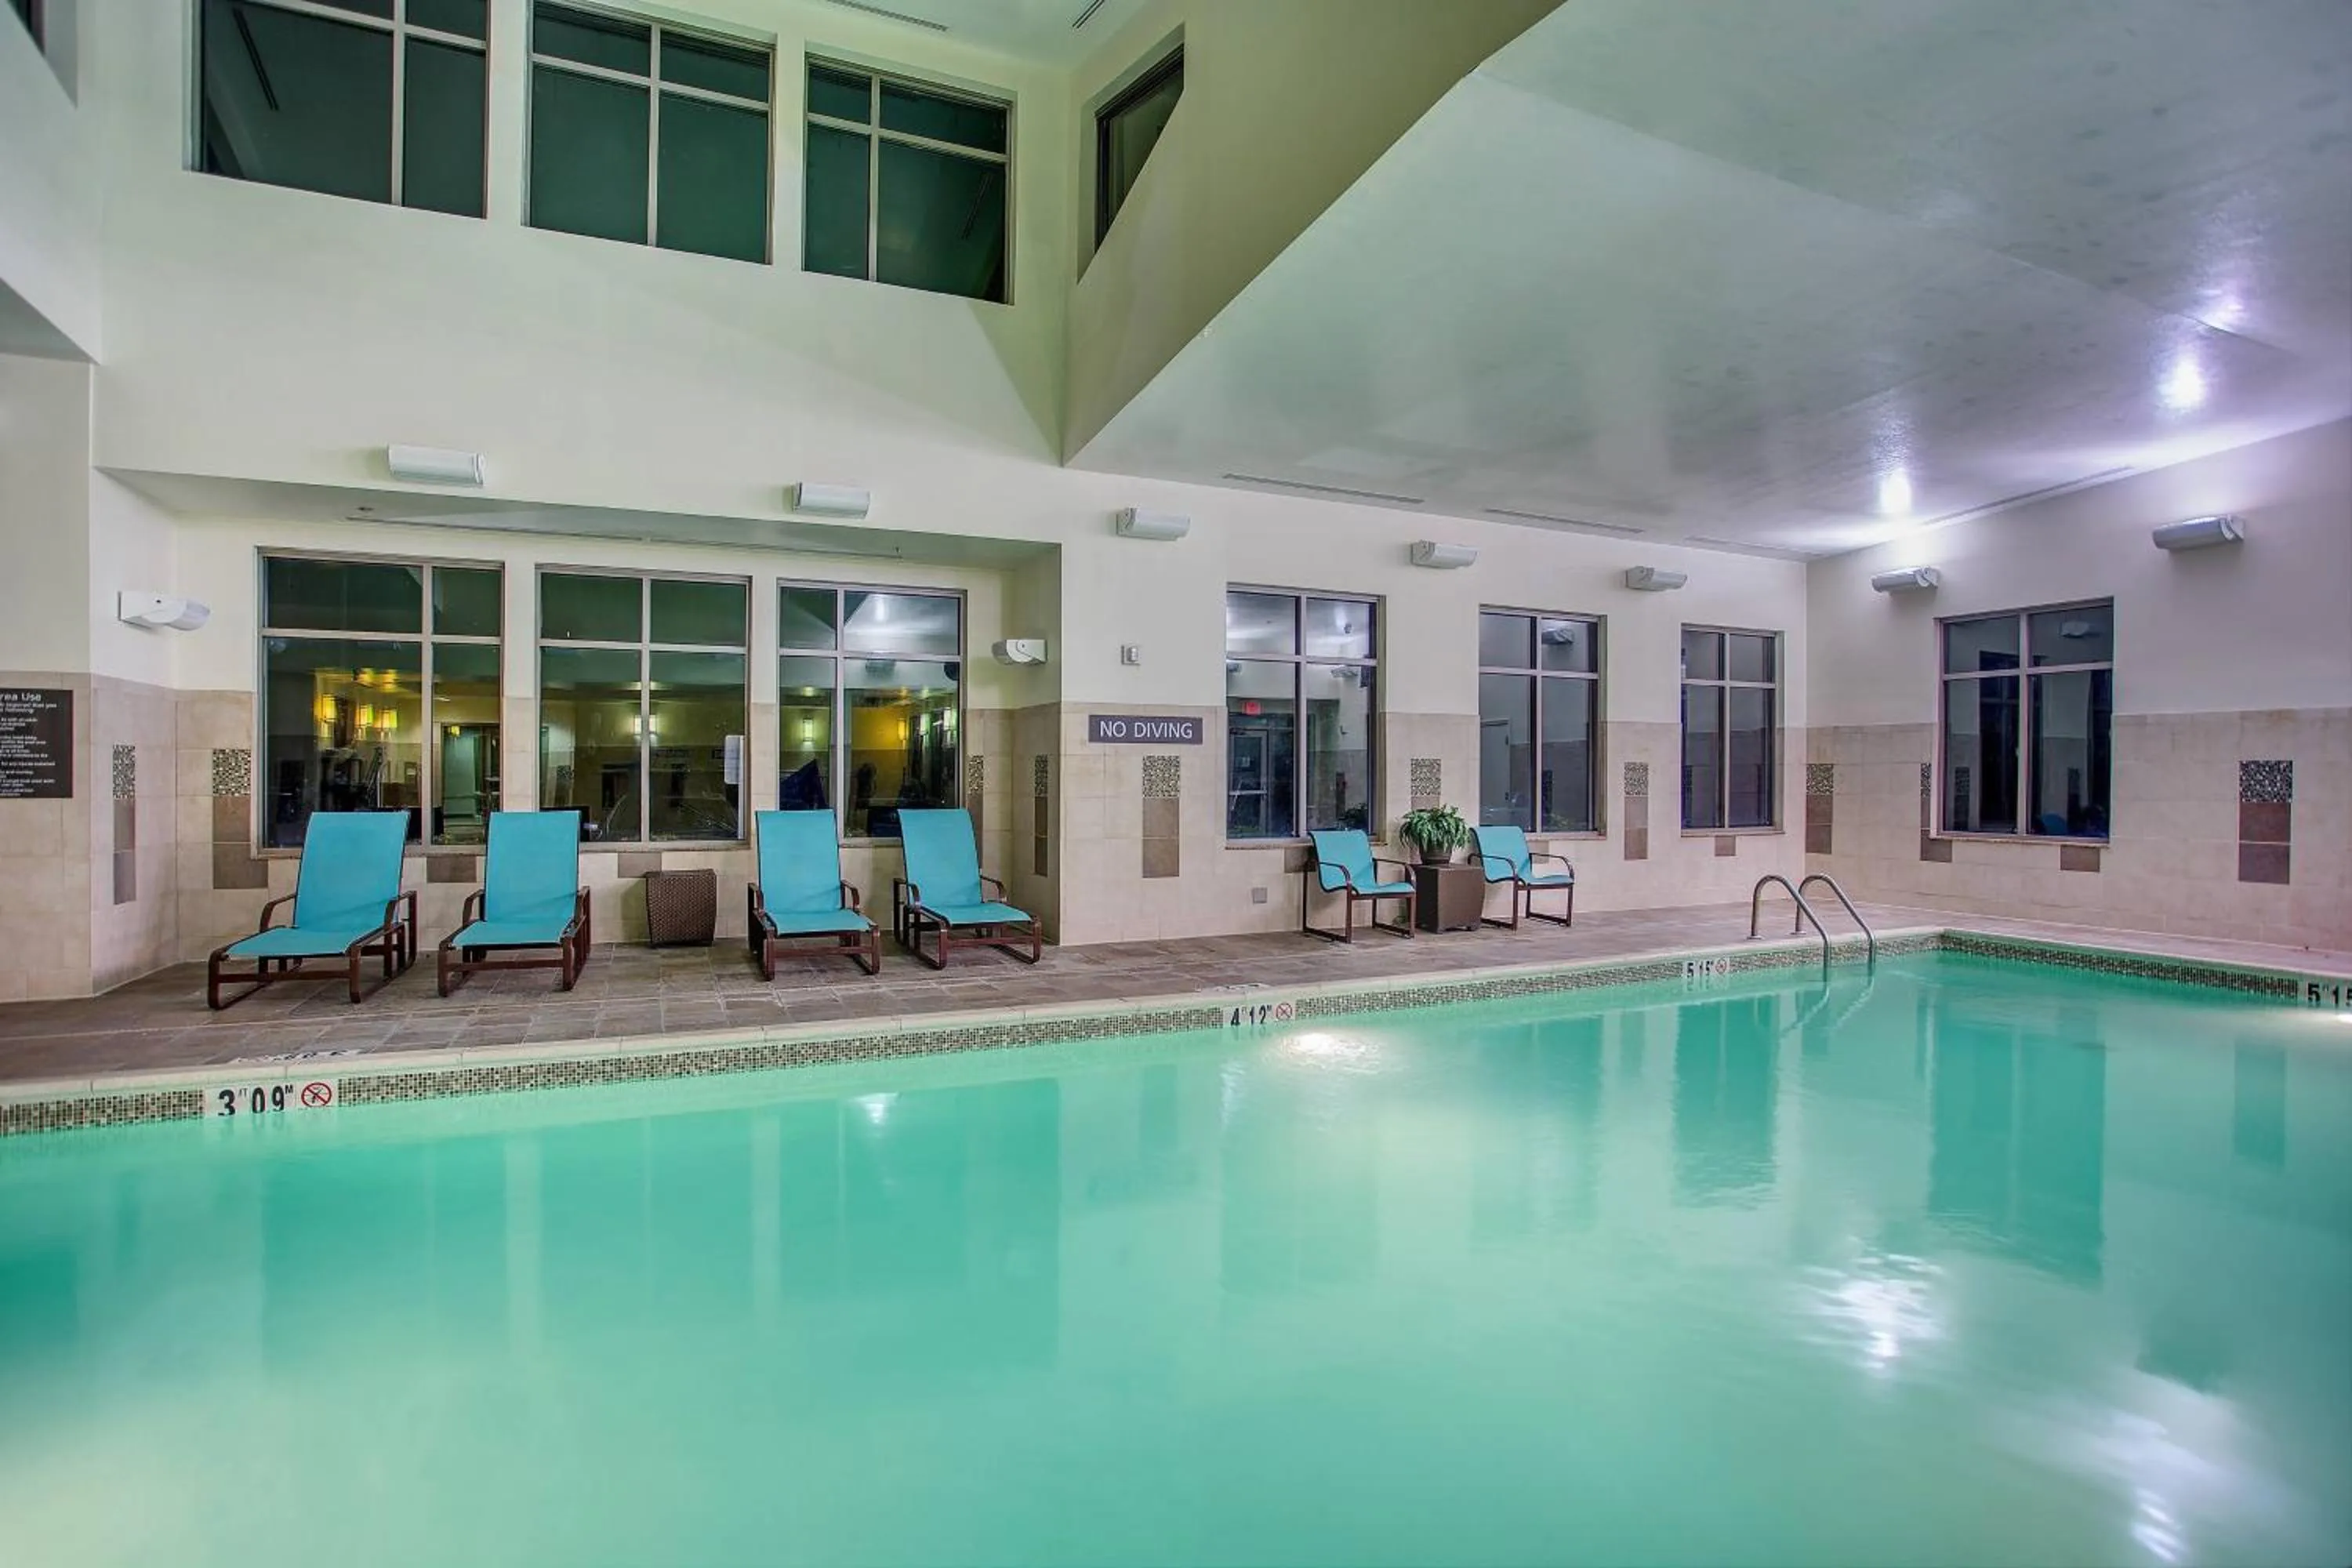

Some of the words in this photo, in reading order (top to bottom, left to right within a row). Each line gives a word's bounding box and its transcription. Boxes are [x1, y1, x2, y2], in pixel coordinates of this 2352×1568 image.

[21, 692, 42, 701] Use
[1099, 720, 1127, 738] NO
[1134, 722, 1193, 739] DIVING
